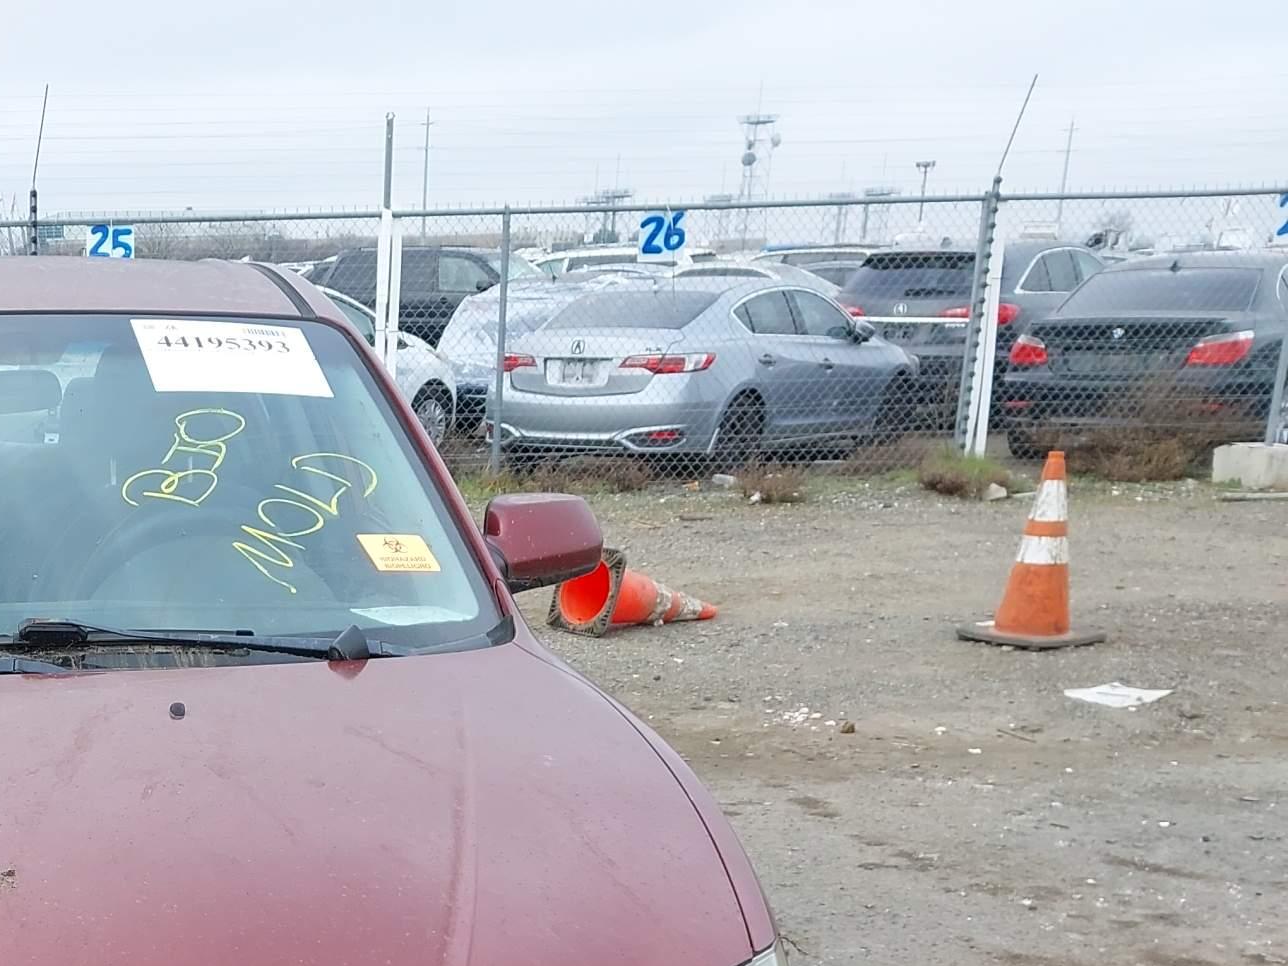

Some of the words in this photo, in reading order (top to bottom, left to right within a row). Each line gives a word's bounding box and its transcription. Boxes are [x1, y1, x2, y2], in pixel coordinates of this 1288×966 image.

[89, 224, 133, 257] 25
[640, 209, 685, 254] 26
[156, 334, 291, 354] 44195393
